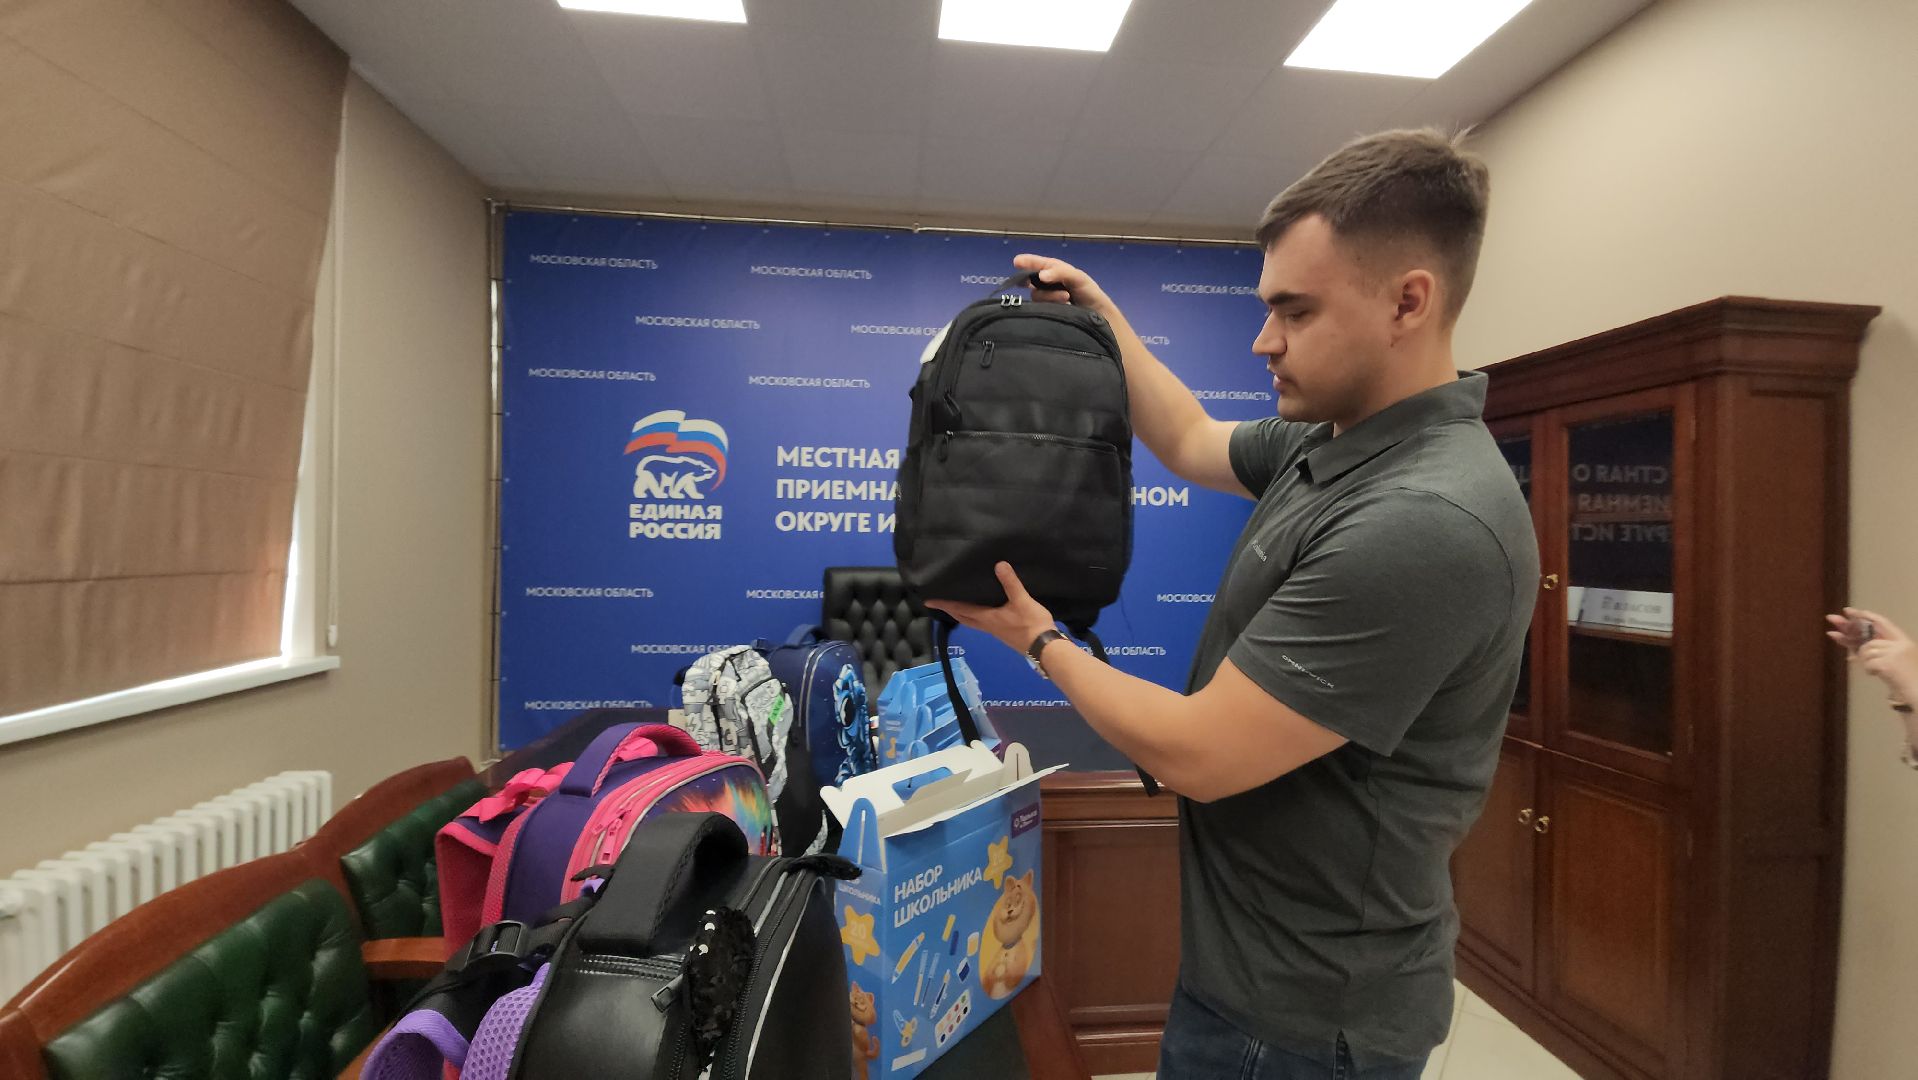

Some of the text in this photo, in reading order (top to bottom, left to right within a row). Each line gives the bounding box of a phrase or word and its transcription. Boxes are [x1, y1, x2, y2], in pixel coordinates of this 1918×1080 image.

[530, 254, 658, 270] МОСКОВСКАЯ ОБЛАСТЬ
[751, 265, 872, 280] МОСКОВСКАЯ ОБЛАСТЬ
[960, 275, 1009, 285] МОСКО
[1161, 283, 1228, 294] МОСКОВСКАЯ
[635, 315, 760, 330] МОСКОВСКАЯ ОБЛАСТЬ
[850, 325, 921, 335] МОСКОВСКАЯ
[528, 368, 657, 382] МОСКОВСКАЯ ОБЛАСТЬ
[748, 376, 871, 389] МОСКОВСКАЯ ОБЛАСТЬ
[1228, 391, 1272, 401] ОБЛАСТЬ
[776, 445, 901, 470] МЕСТНАЯ
[776, 478, 1189, 507] ПРИЕМНА НОМ
[629, 503, 723, 520] ЕДИНАЯ
[775, 509, 897, 533] ОКРУГЕ И
[629, 521, 722, 540] РОССИЯ
[526, 586, 654, 598] МОСКОВСКАЯ ОБЛАСТЬ
[746, 589, 818, 599] МОСКОВСКАЯ
[1156, 593, 1216, 603] МОСКОВСК
[631, 644, 706, 654] МОСКОВСКАЯ
[1121, 646, 1167, 656] ОБЛАСТЬ
[525, 700, 600, 710] МОСКОВСКАЯ
[894, 864, 943, 904] НАБОР
[894, 866, 982, 928] ШКОЛЬНИКА
